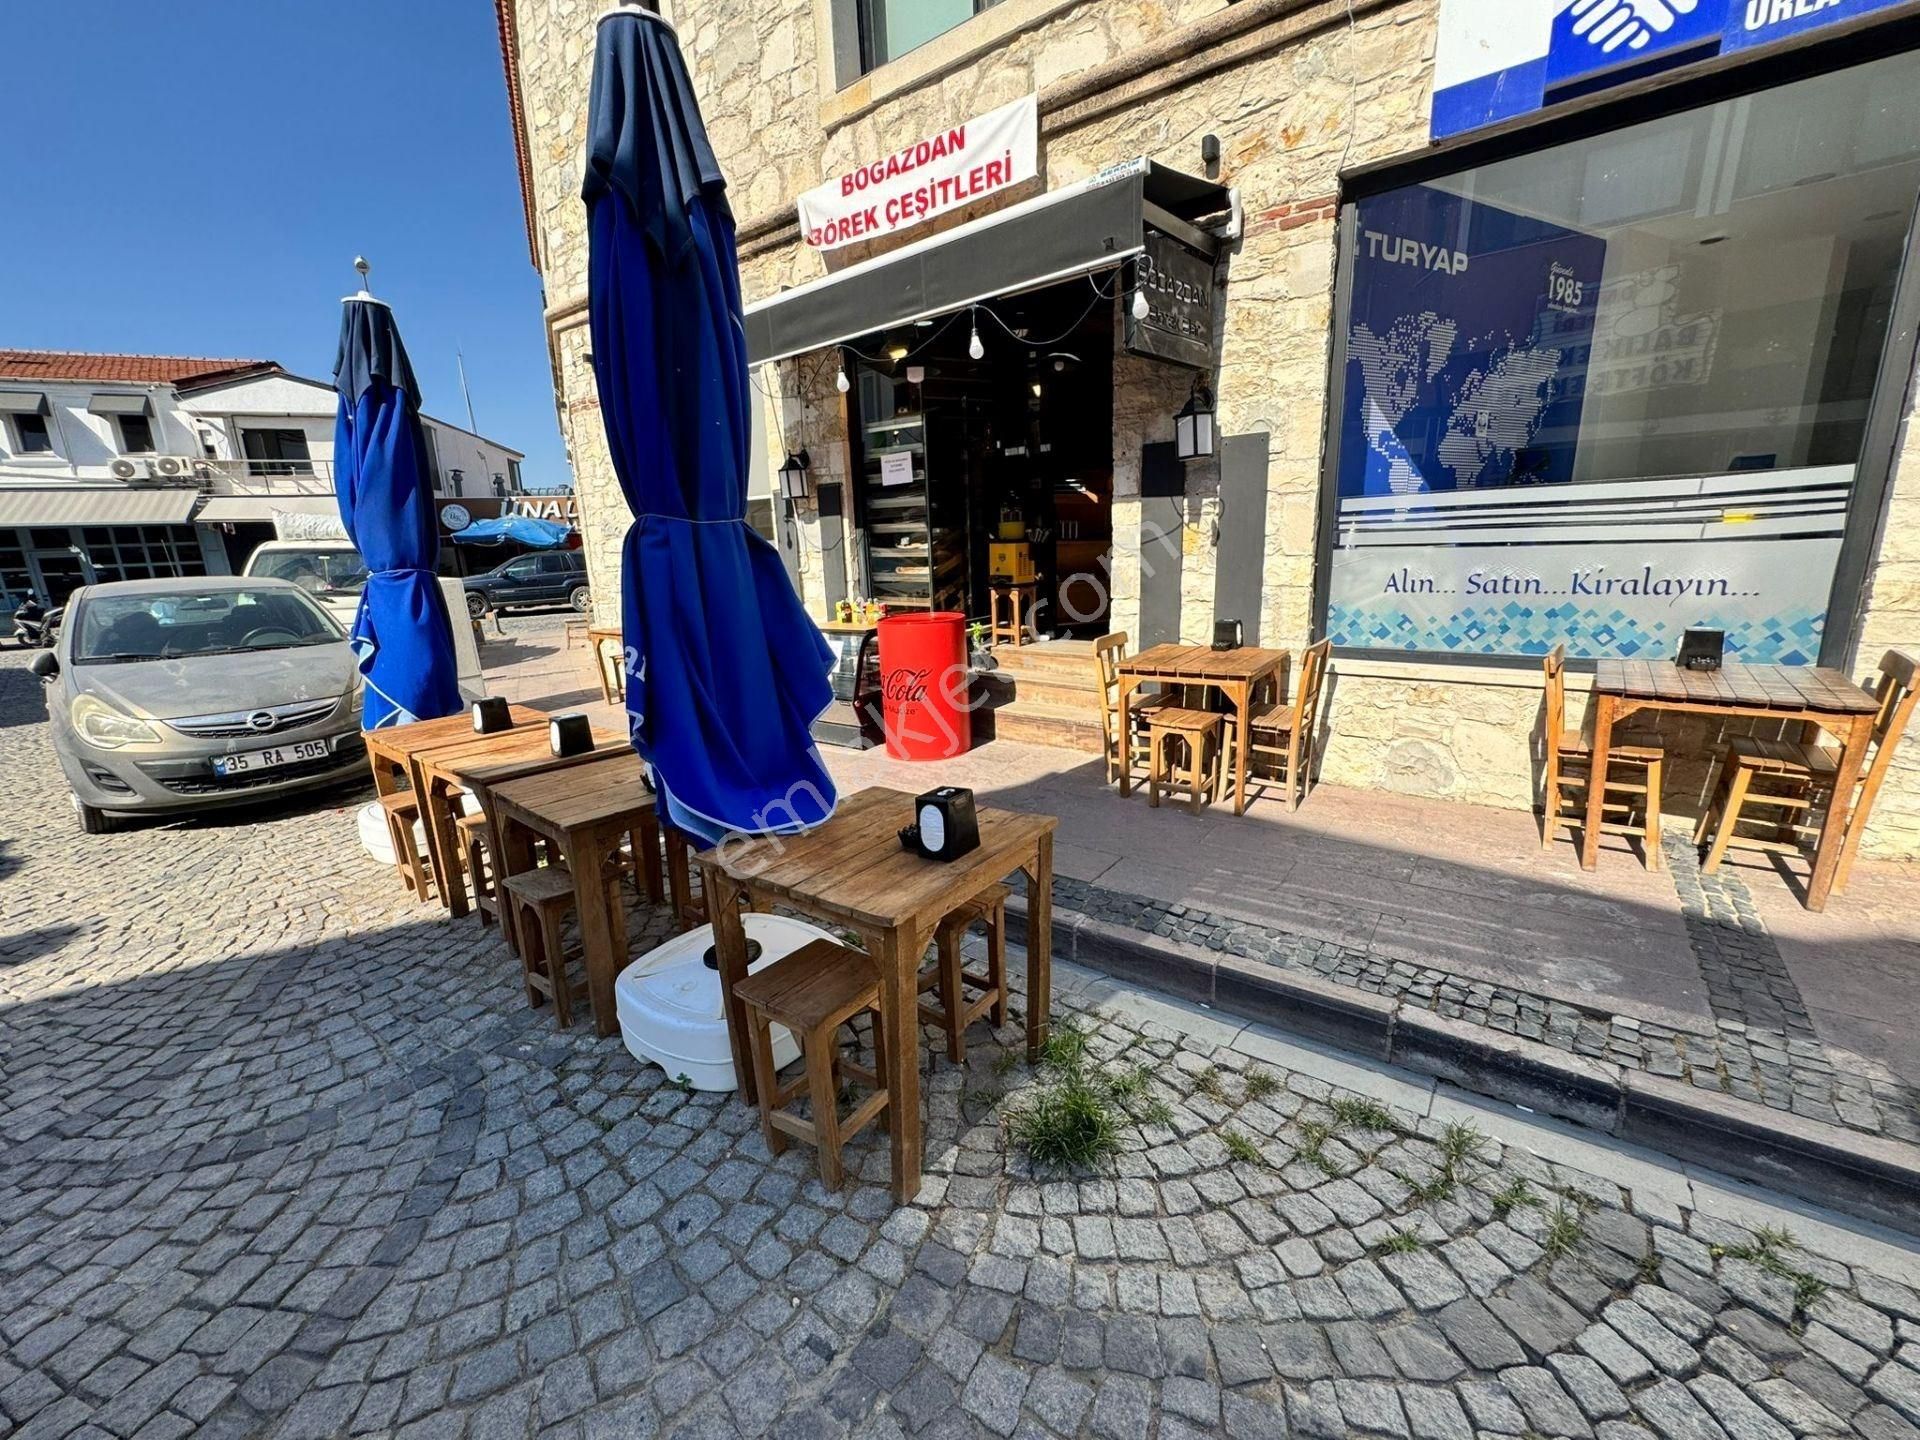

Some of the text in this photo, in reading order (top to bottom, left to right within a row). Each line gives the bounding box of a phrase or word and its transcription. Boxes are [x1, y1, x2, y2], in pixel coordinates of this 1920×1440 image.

[1744, 0, 1841, 31] UR
[885, 150, 1012, 230] ÇEŞİTLERİ
[1364, 230, 1469, 275] TURYAP
[1549, 275, 1583, 306] 1985
[226, 755, 249, 772] 35
[262, 749, 285, 766] RA
[294, 741, 325, 760] 505
